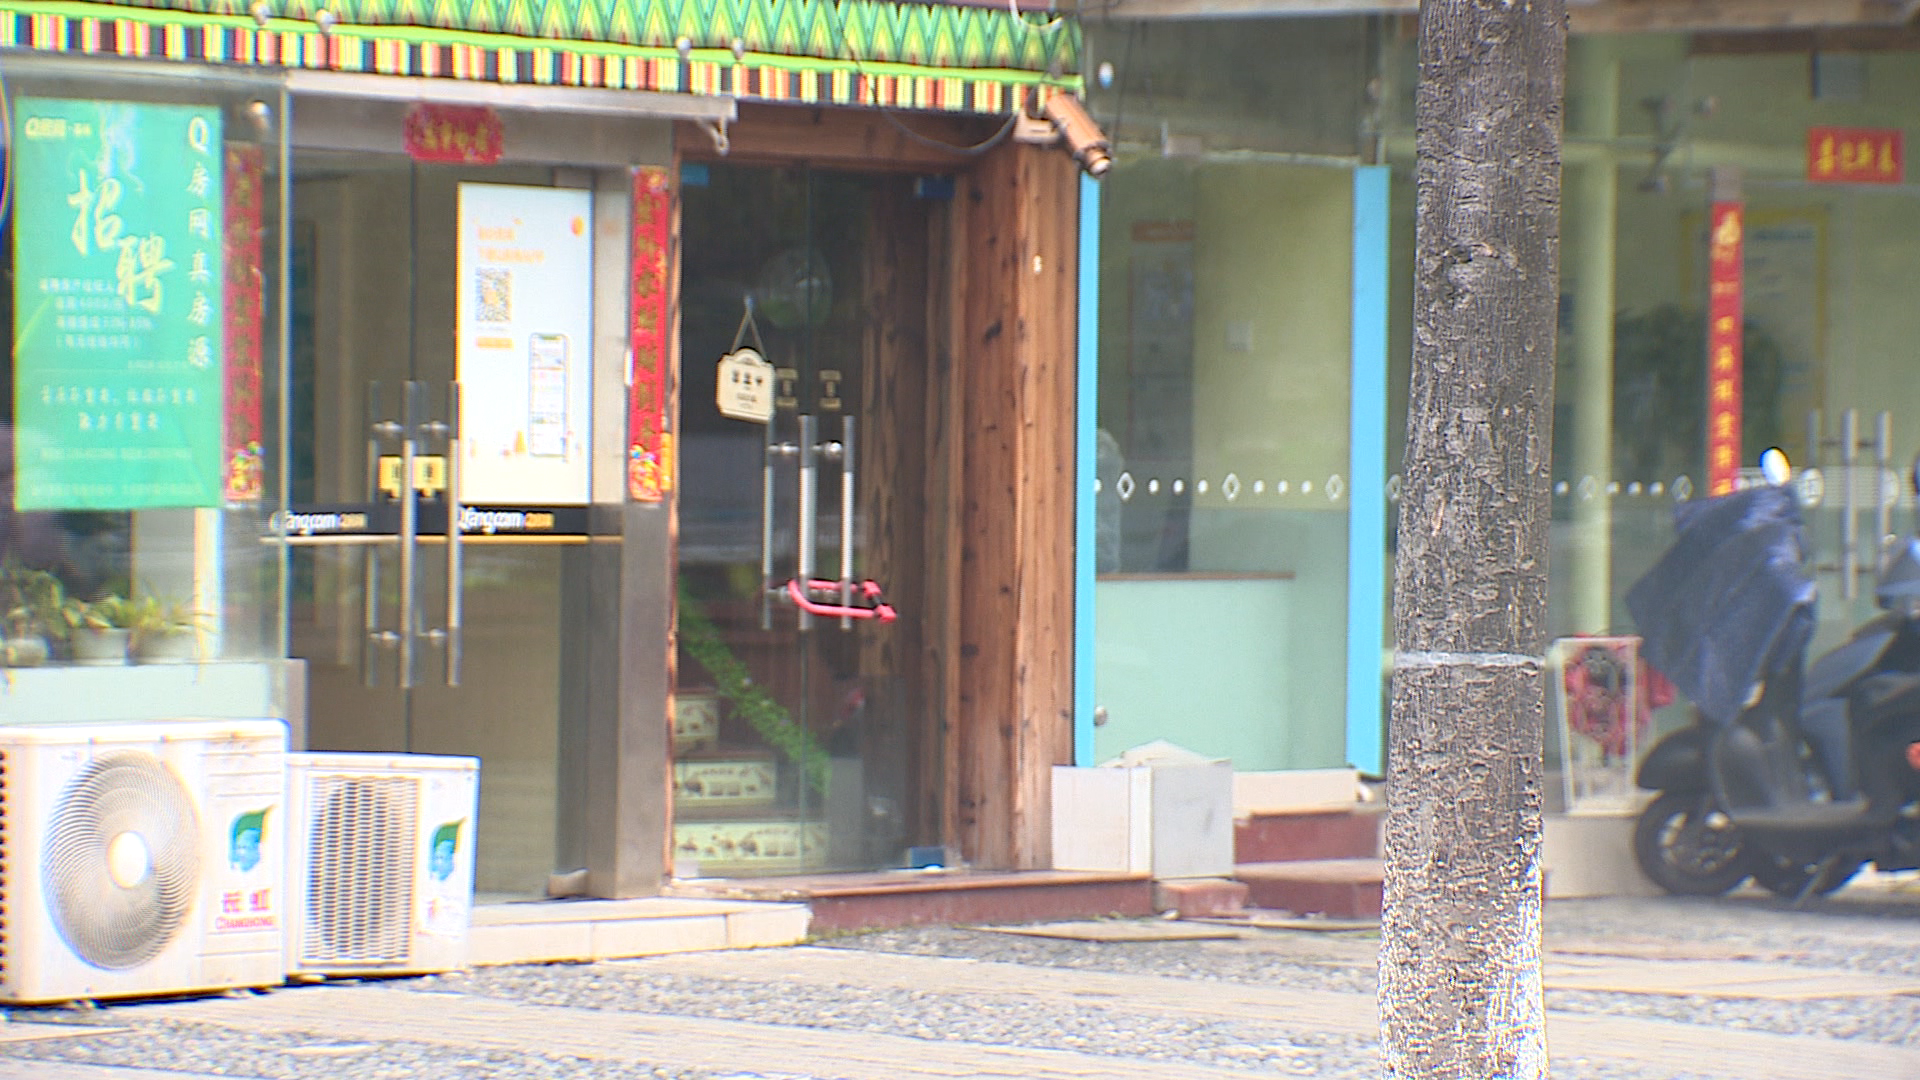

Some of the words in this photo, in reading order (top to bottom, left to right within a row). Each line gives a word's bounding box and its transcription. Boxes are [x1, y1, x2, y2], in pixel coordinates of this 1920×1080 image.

[67, 168, 175, 313] 招聘
[187, 116, 213, 369] Q房网真房源
[222, 888, 271, 913] 长虹
